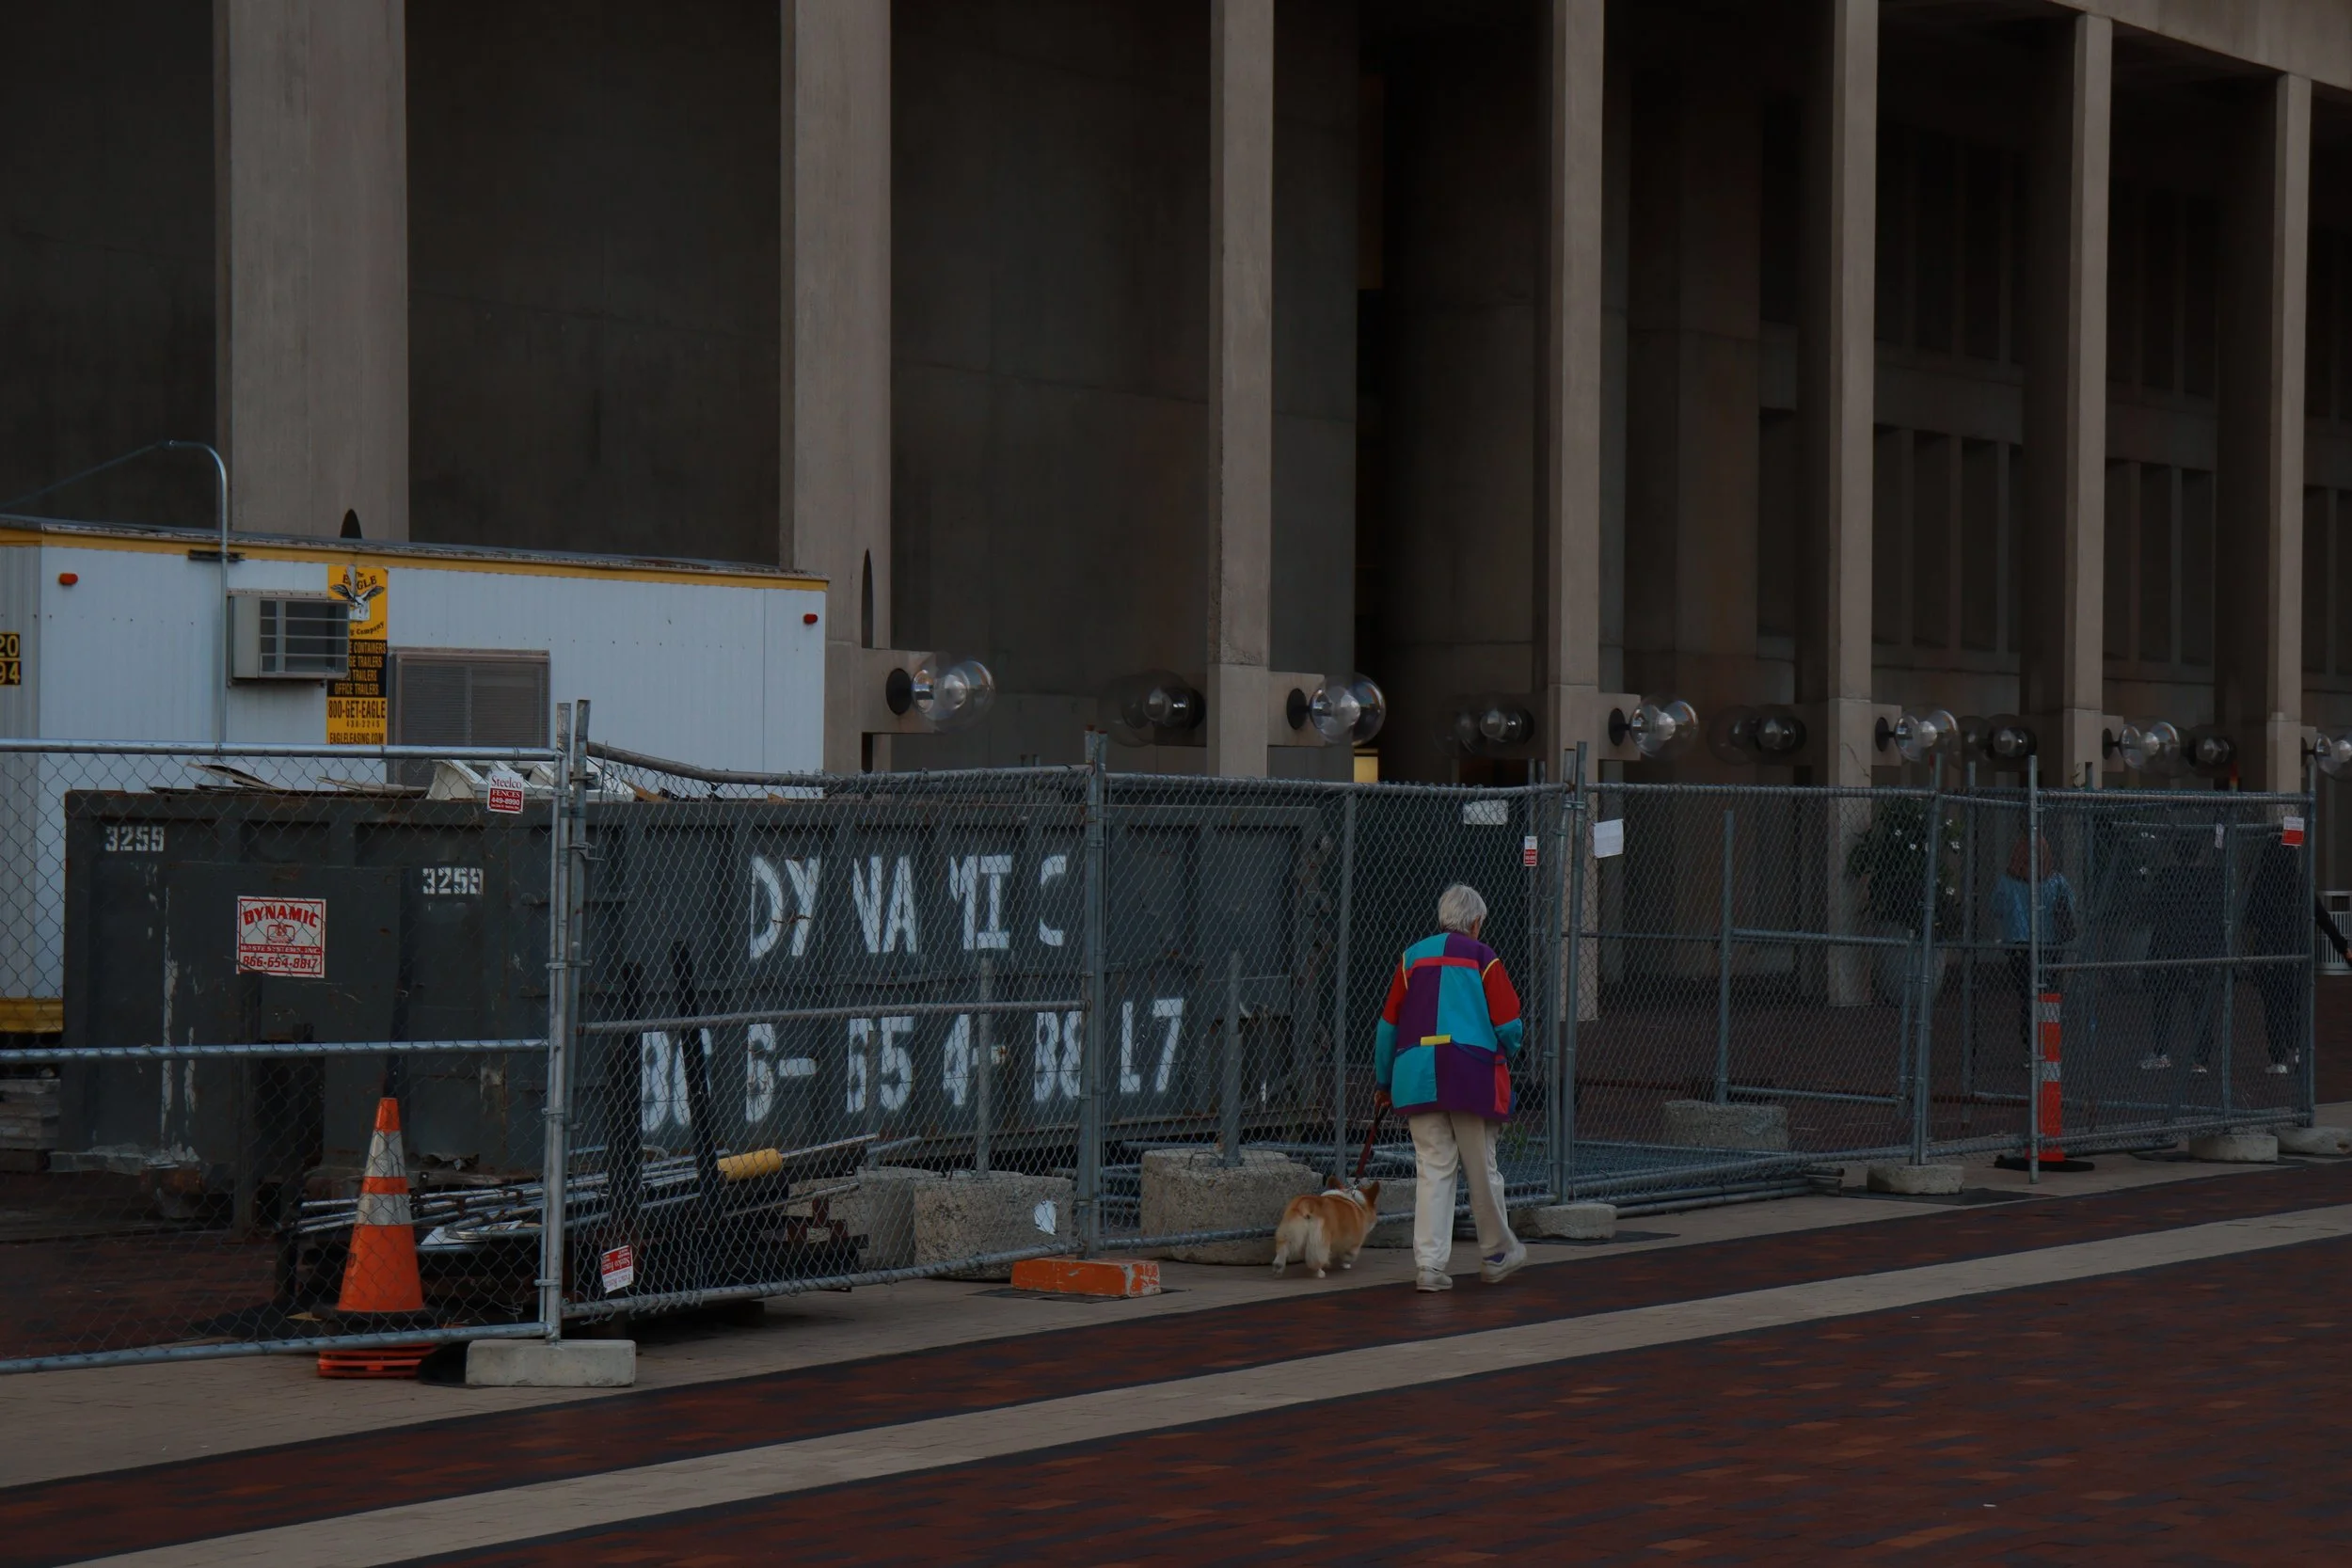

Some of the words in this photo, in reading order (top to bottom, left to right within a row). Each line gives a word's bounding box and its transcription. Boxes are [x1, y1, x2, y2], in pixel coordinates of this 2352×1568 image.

[342, 574, 377, 591] EGLE
[356, 621, 385, 635] Company
[353, 641, 387, 654] CONTAINERS
[358, 656, 384, 668] TRAILERS
[352, 669, 377, 682] TRAILERS
[334, 683, 354, 695] OFFICE
[355, 683, 380, 695] TRAILERS
[328, 700, 386, 718] 800-GET-EAGLE
[329, 733, 384, 744] EAGLELEASING.COM
[491, 775, 522, 789] Steelco
[105, 826, 165, 852] 3259
[422, 867, 484, 895] 3259
[244, 905, 319, 928] DYNAMIC
[243, 956, 318, 970] 866-654-8817
